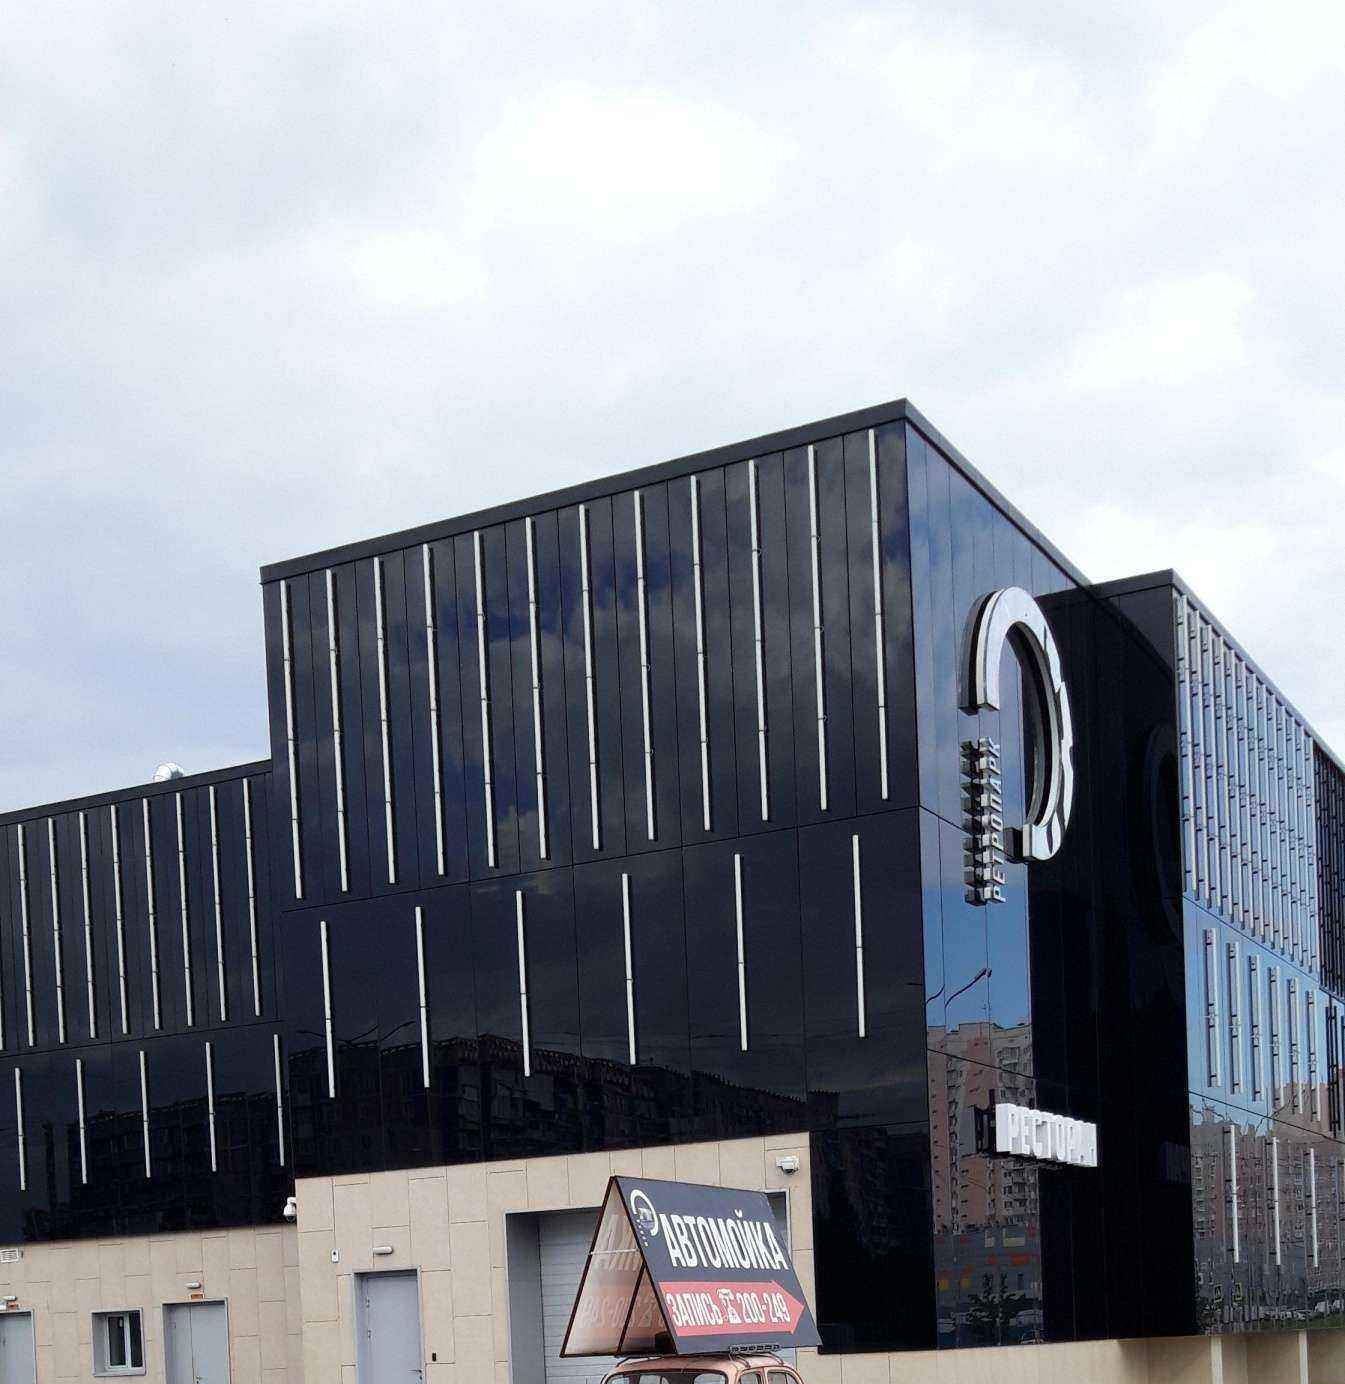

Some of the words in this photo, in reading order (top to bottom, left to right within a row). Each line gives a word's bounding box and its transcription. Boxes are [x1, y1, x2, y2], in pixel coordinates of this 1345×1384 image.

[980, 736, 1006, 903] РЕТРОПАРК
[659, 1209, 788, 1270] АВТОМОЙКА
[666, 1292, 723, 1327] ЗАПИСЬ
[736, 1292, 790, 1324] 200-249
